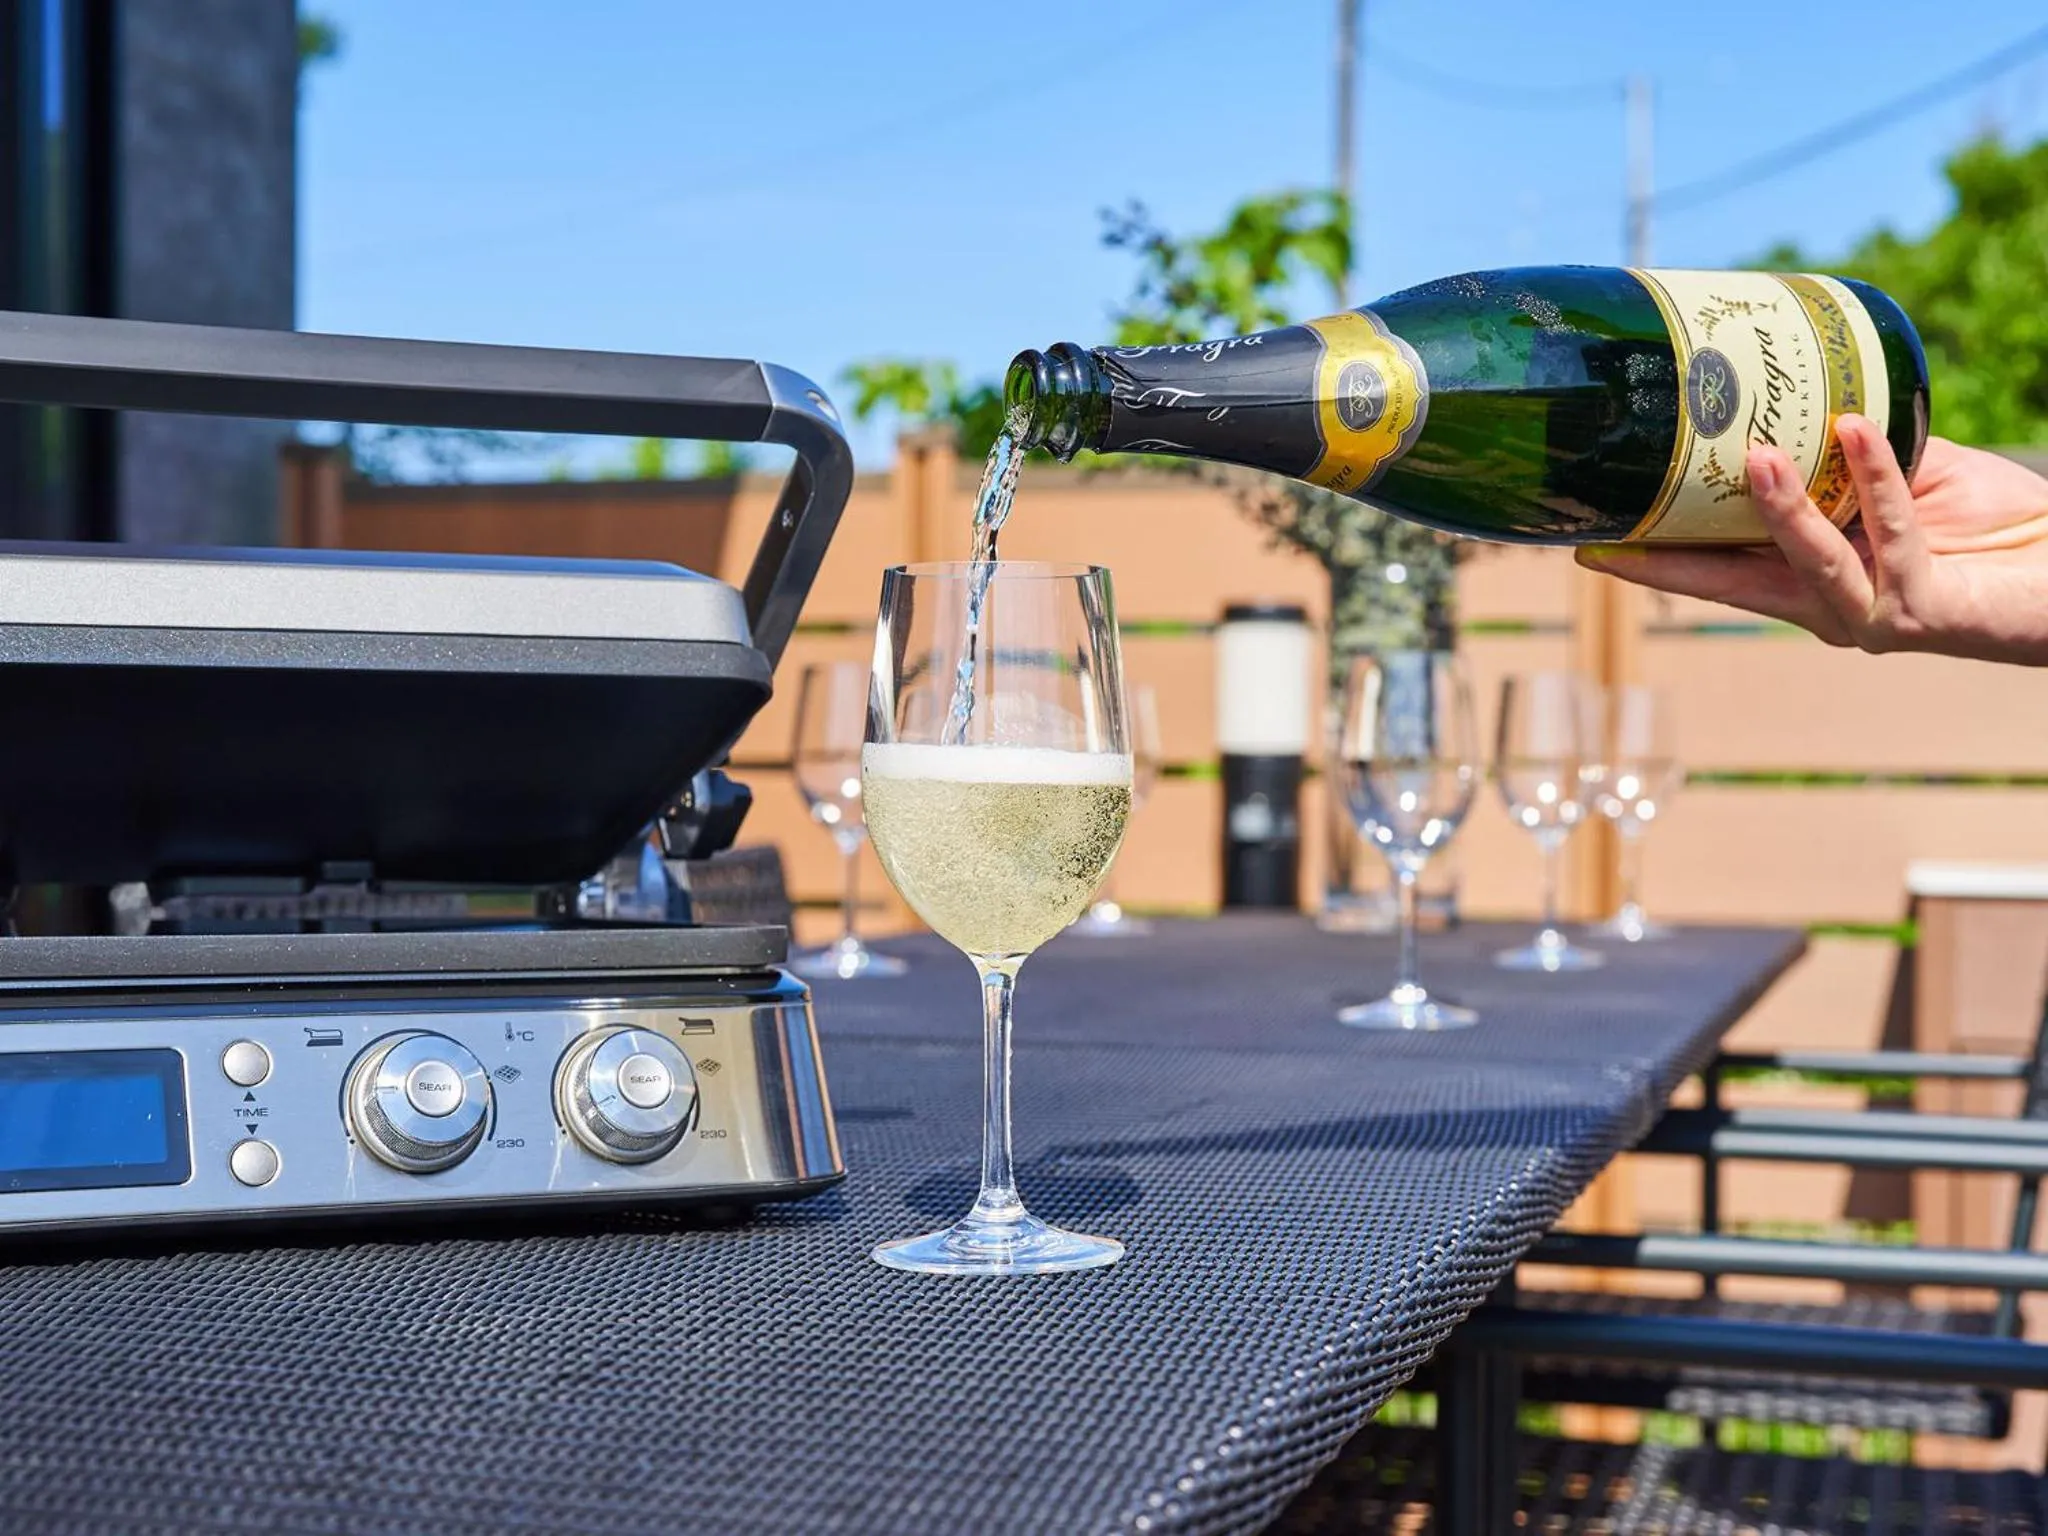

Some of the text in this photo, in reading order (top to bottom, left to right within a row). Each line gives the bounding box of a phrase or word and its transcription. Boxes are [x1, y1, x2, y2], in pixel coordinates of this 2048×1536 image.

[233, 1107, 270, 1118] TIME
[700, 1129, 727, 1140] 230
[496, 1139, 525, 1149] 230
